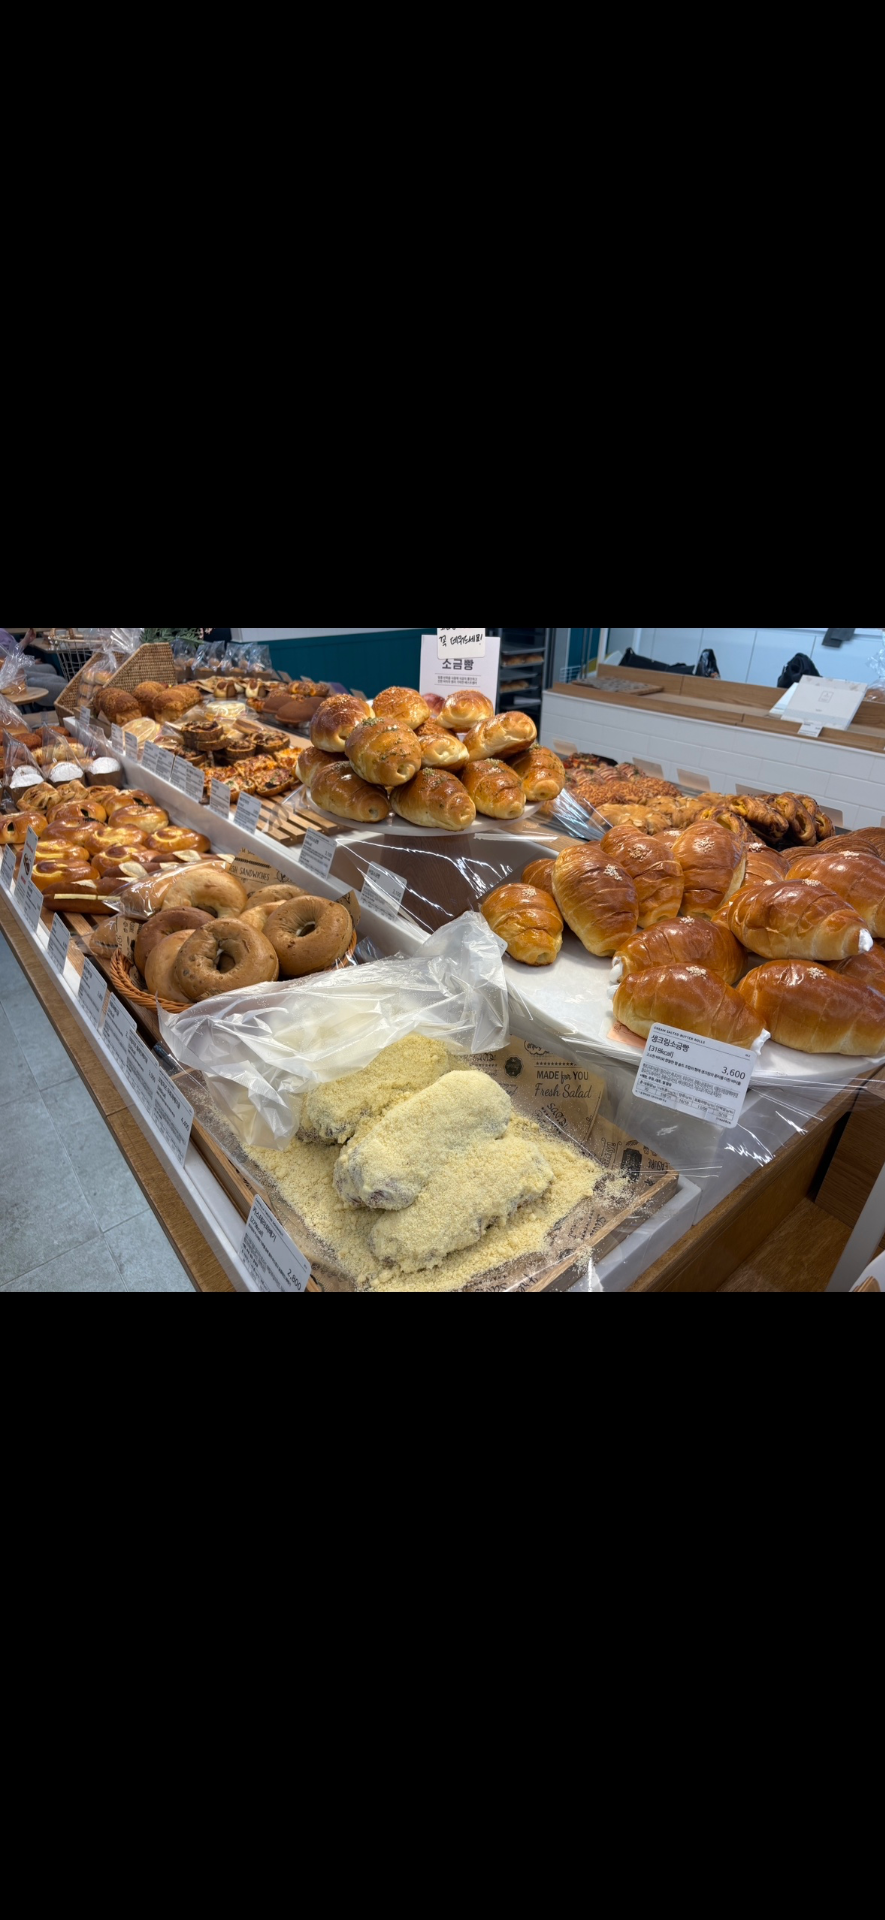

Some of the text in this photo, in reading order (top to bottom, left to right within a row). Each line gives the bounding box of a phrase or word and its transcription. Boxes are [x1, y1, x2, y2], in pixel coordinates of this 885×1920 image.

[442, 658, 474, 670] 소금빵
[651, 1034, 690, 1052] 생크림소금빵
[536, 1070, 589, 1085] MADE for YOU
[721, 1066, 746, 1080] 3,600
[534, 1083, 593, 1099] Fresh Salad
